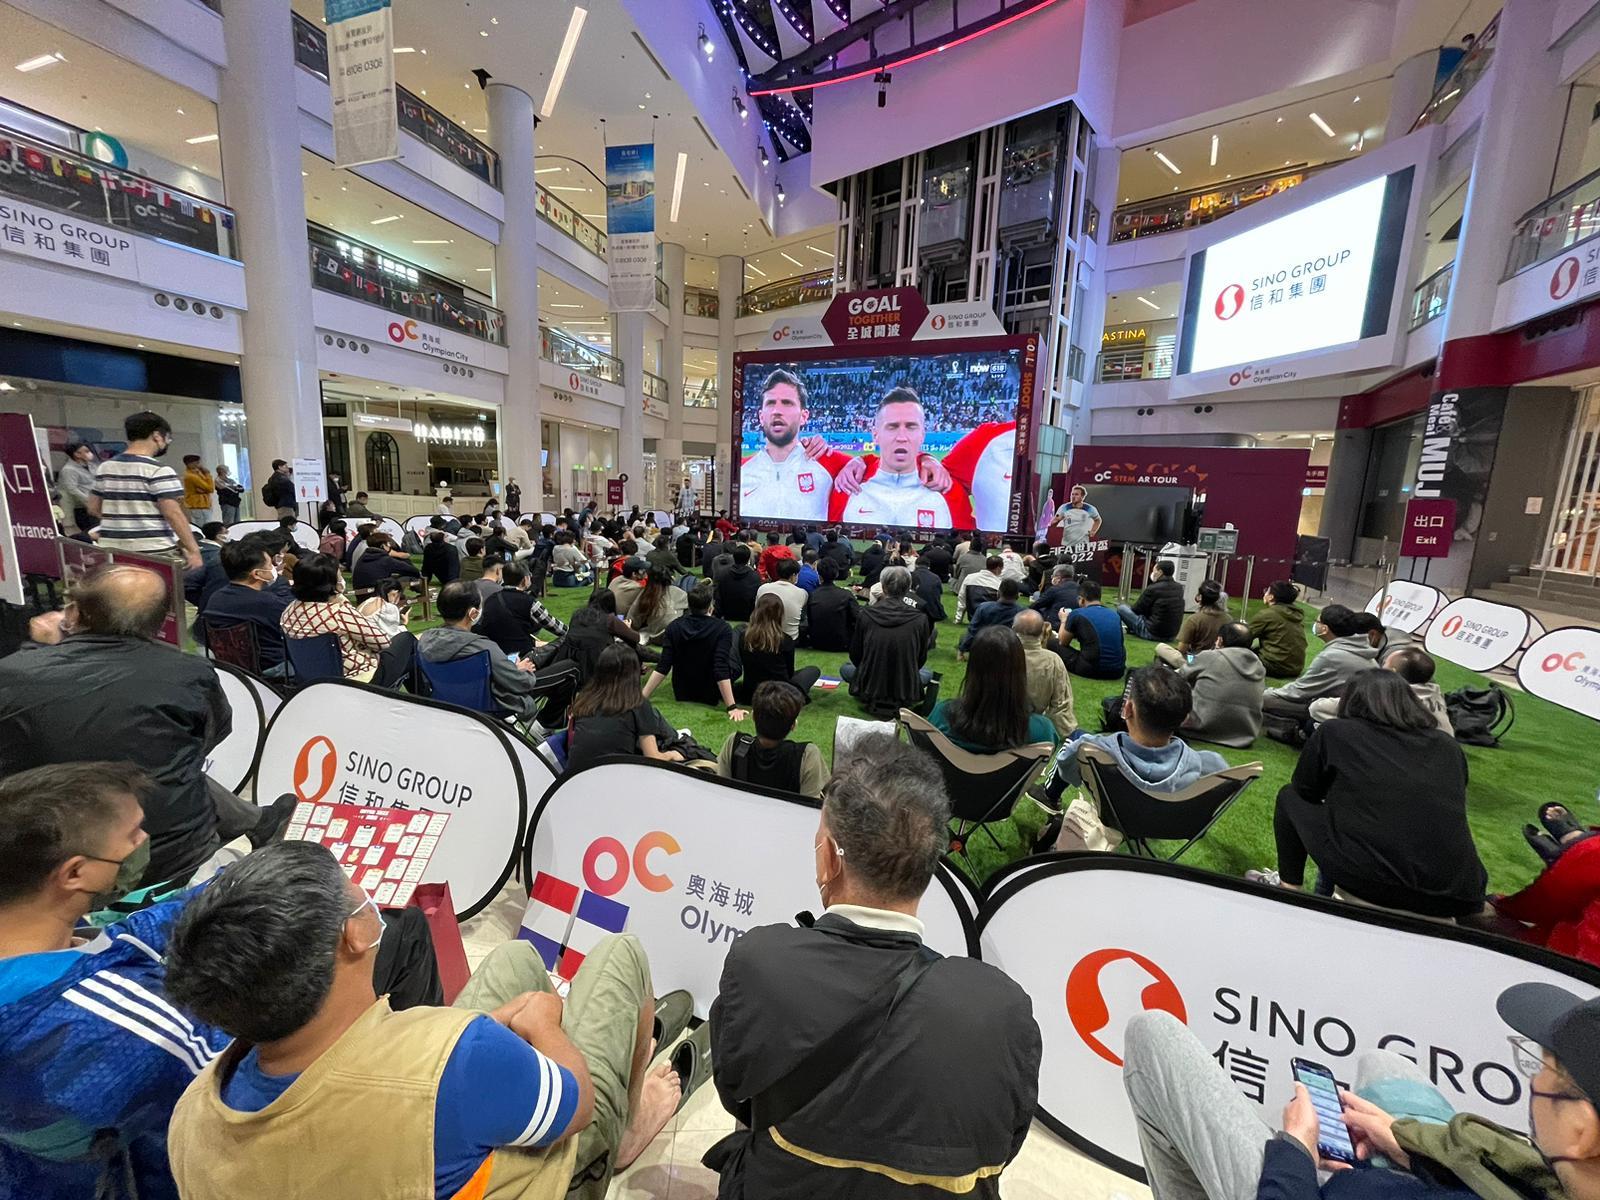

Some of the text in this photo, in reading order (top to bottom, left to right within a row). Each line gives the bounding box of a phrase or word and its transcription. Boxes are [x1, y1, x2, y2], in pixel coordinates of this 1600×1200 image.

[0, 205, 54, 231] SINO
[60, 223, 130, 251] GROUP
[2, 223, 110, 267] 信和集團
[1251, 249, 1351, 291] SINO GROUP
[1250, 274, 1327, 312] 信和集團
[848, 295, 901, 315] GOAL
[849, 311, 901, 326] TOGETHER
[388, 320, 418, 343] OC
[773, 326, 791, 341] OC
[847, 323, 901, 341] 全城開波
[422, 342, 469, 362] Olympian City
[1229, 366, 1252, 387] OC
[1253, 371, 1297, 383] Olympian City
[1021, 372, 1033, 409] SHOOT
[1425, 404, 1440, 435] Meal
[1094, 470, 1112, 482] OC
[1114, 475, 1136, 483] STEM
[1153, 476, 1178, 484] TOUR
[1009, 492, 1022, 534] VICTORY
[1414, 515, 1444, 528] 出口
[1416, 536, 1437, 545] Exit
[1464, 619, 1509, 639] SINO GROUP
[1541, 652, 1585, 672] OC
[345, 751, 473, 808] SINO GROUP
[582, 831, 682, 897] OC
[1213, 987, 1356, 1058] SINO
